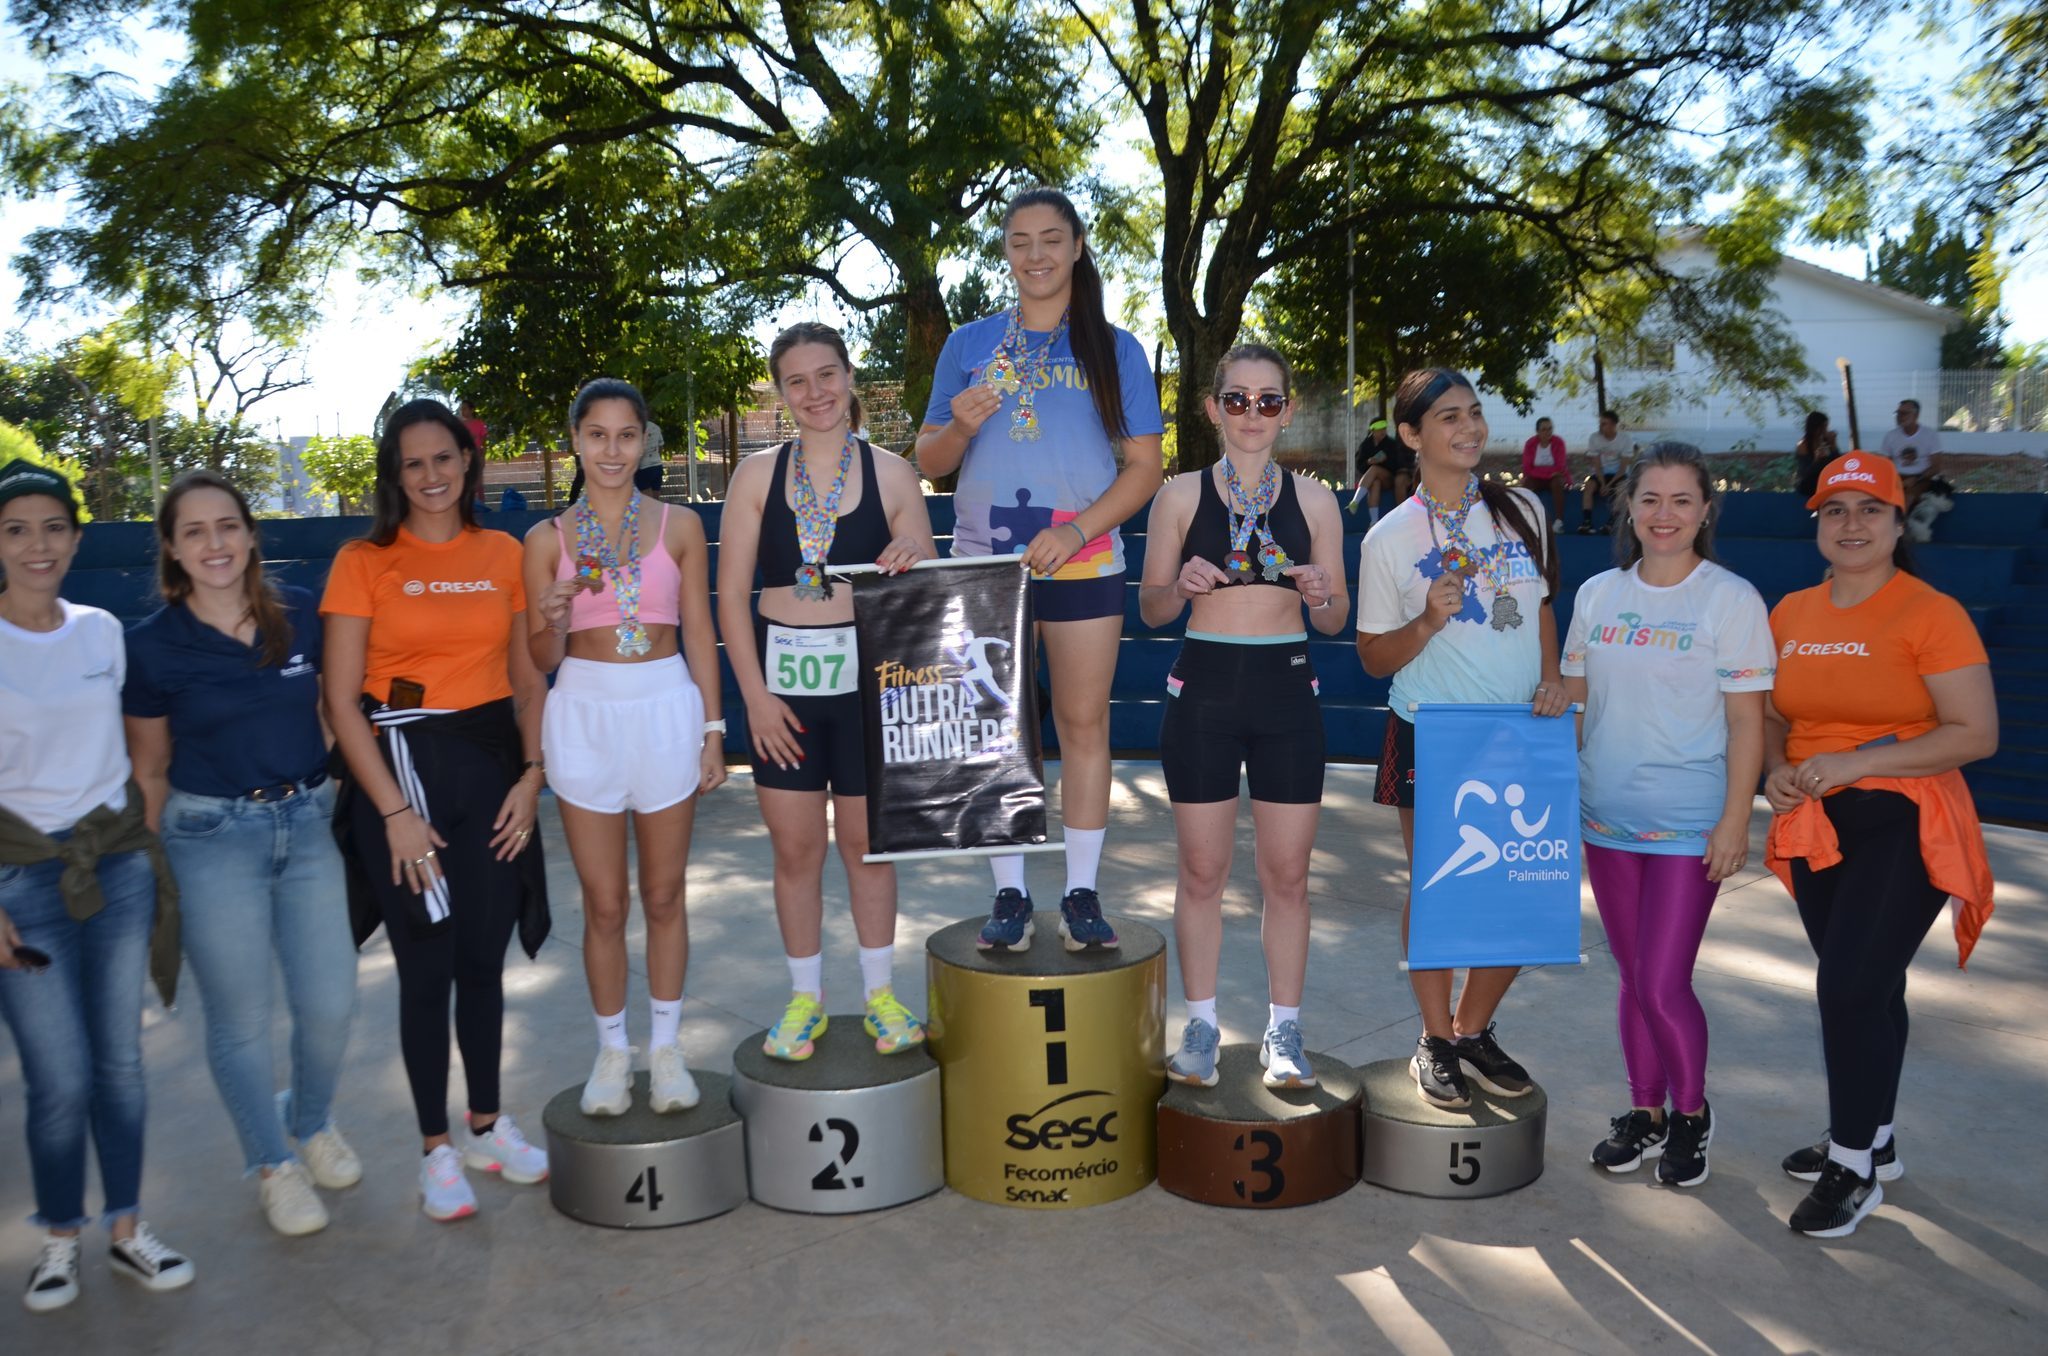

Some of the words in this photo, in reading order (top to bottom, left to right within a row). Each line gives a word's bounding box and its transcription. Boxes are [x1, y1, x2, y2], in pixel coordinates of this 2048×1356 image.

[1827, 472, 1877, 486] CRESOL
[428, 579, 498, 593] CRESOL
[1589, 623, 1693, 653] Autismo
[1797, 641, 1870, 657] CRESOL
[777, 653, 846, 690] 507
[874, 660, 944, 694] Fitness
[881, 684, 977, 725] DUTRA
[882, 717, 1019, 764] RUNNERS
[1502, 839, 1569, 862] GCOR
[1508, 868, 1570, 882] Palmitinho
[1029, 987, 1068, 1086] 1
[1004, 1108, 1119, 1151] Sesc
[808, 1117, 864, 1191] 2
[1004, 1158, 1119, 1182] Fecomércio
[1233, 1129, 1286, 1204] 3
[1448, 1141, 1482, 1187] 5
[625, 1166, 664, 1212] 4
[1005, 1185, 1069, 1203] Senac
